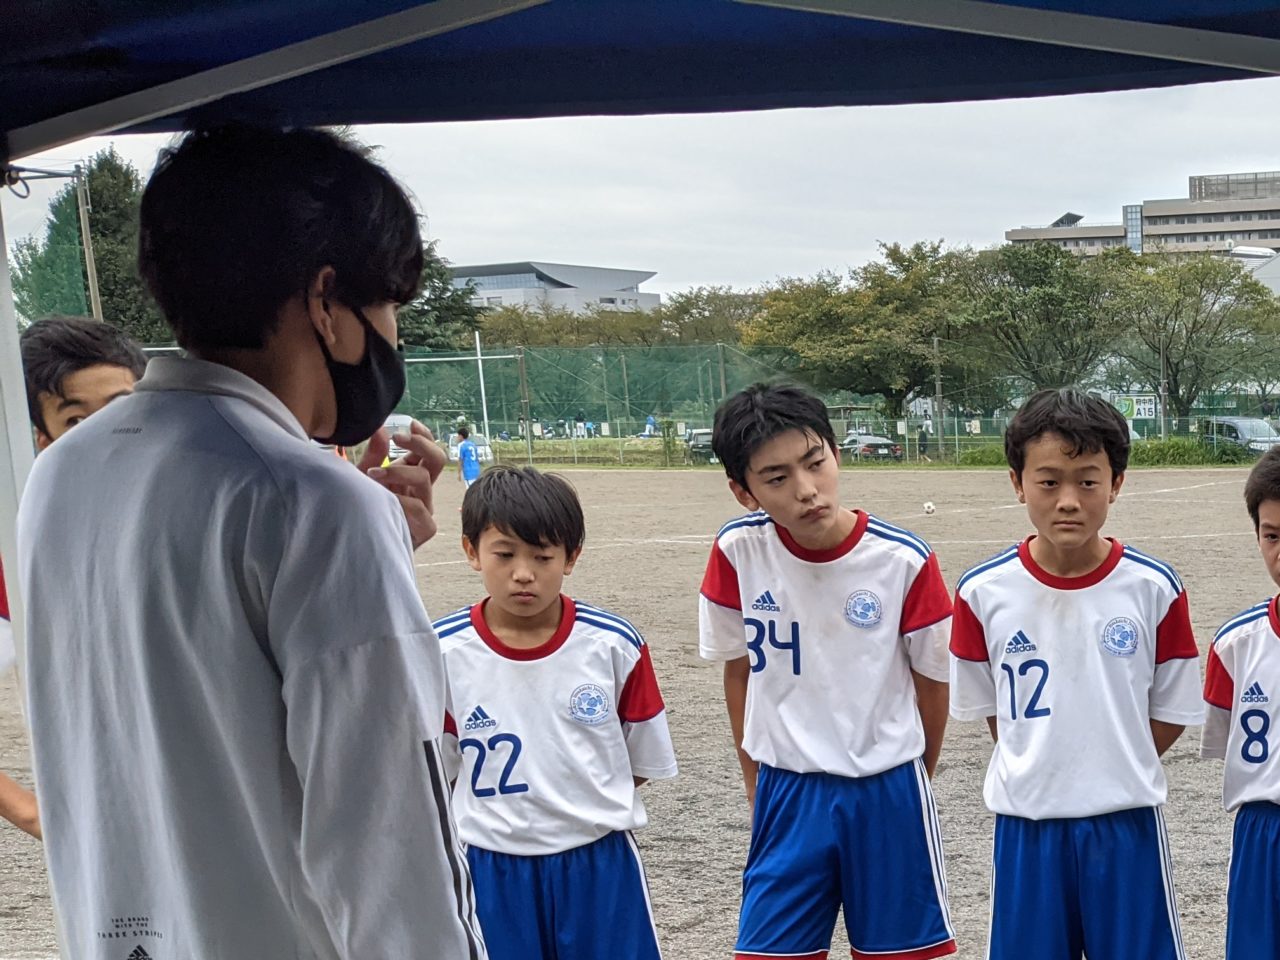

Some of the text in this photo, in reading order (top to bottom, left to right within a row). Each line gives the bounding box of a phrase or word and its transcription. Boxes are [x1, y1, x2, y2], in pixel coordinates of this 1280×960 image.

[1136, 408, 1154, 416] A15
[751, 603, 781, 612] adidas
[1005, 644, 1037, 654] adidas
[1001, 659, 1051, 720] 12
[1241, 695, 1269, 703] adidas
[465, 718, 496, 730] adidas
[1240, 709, 1270, 763] 8
[459, 733, 529, 797] 22
